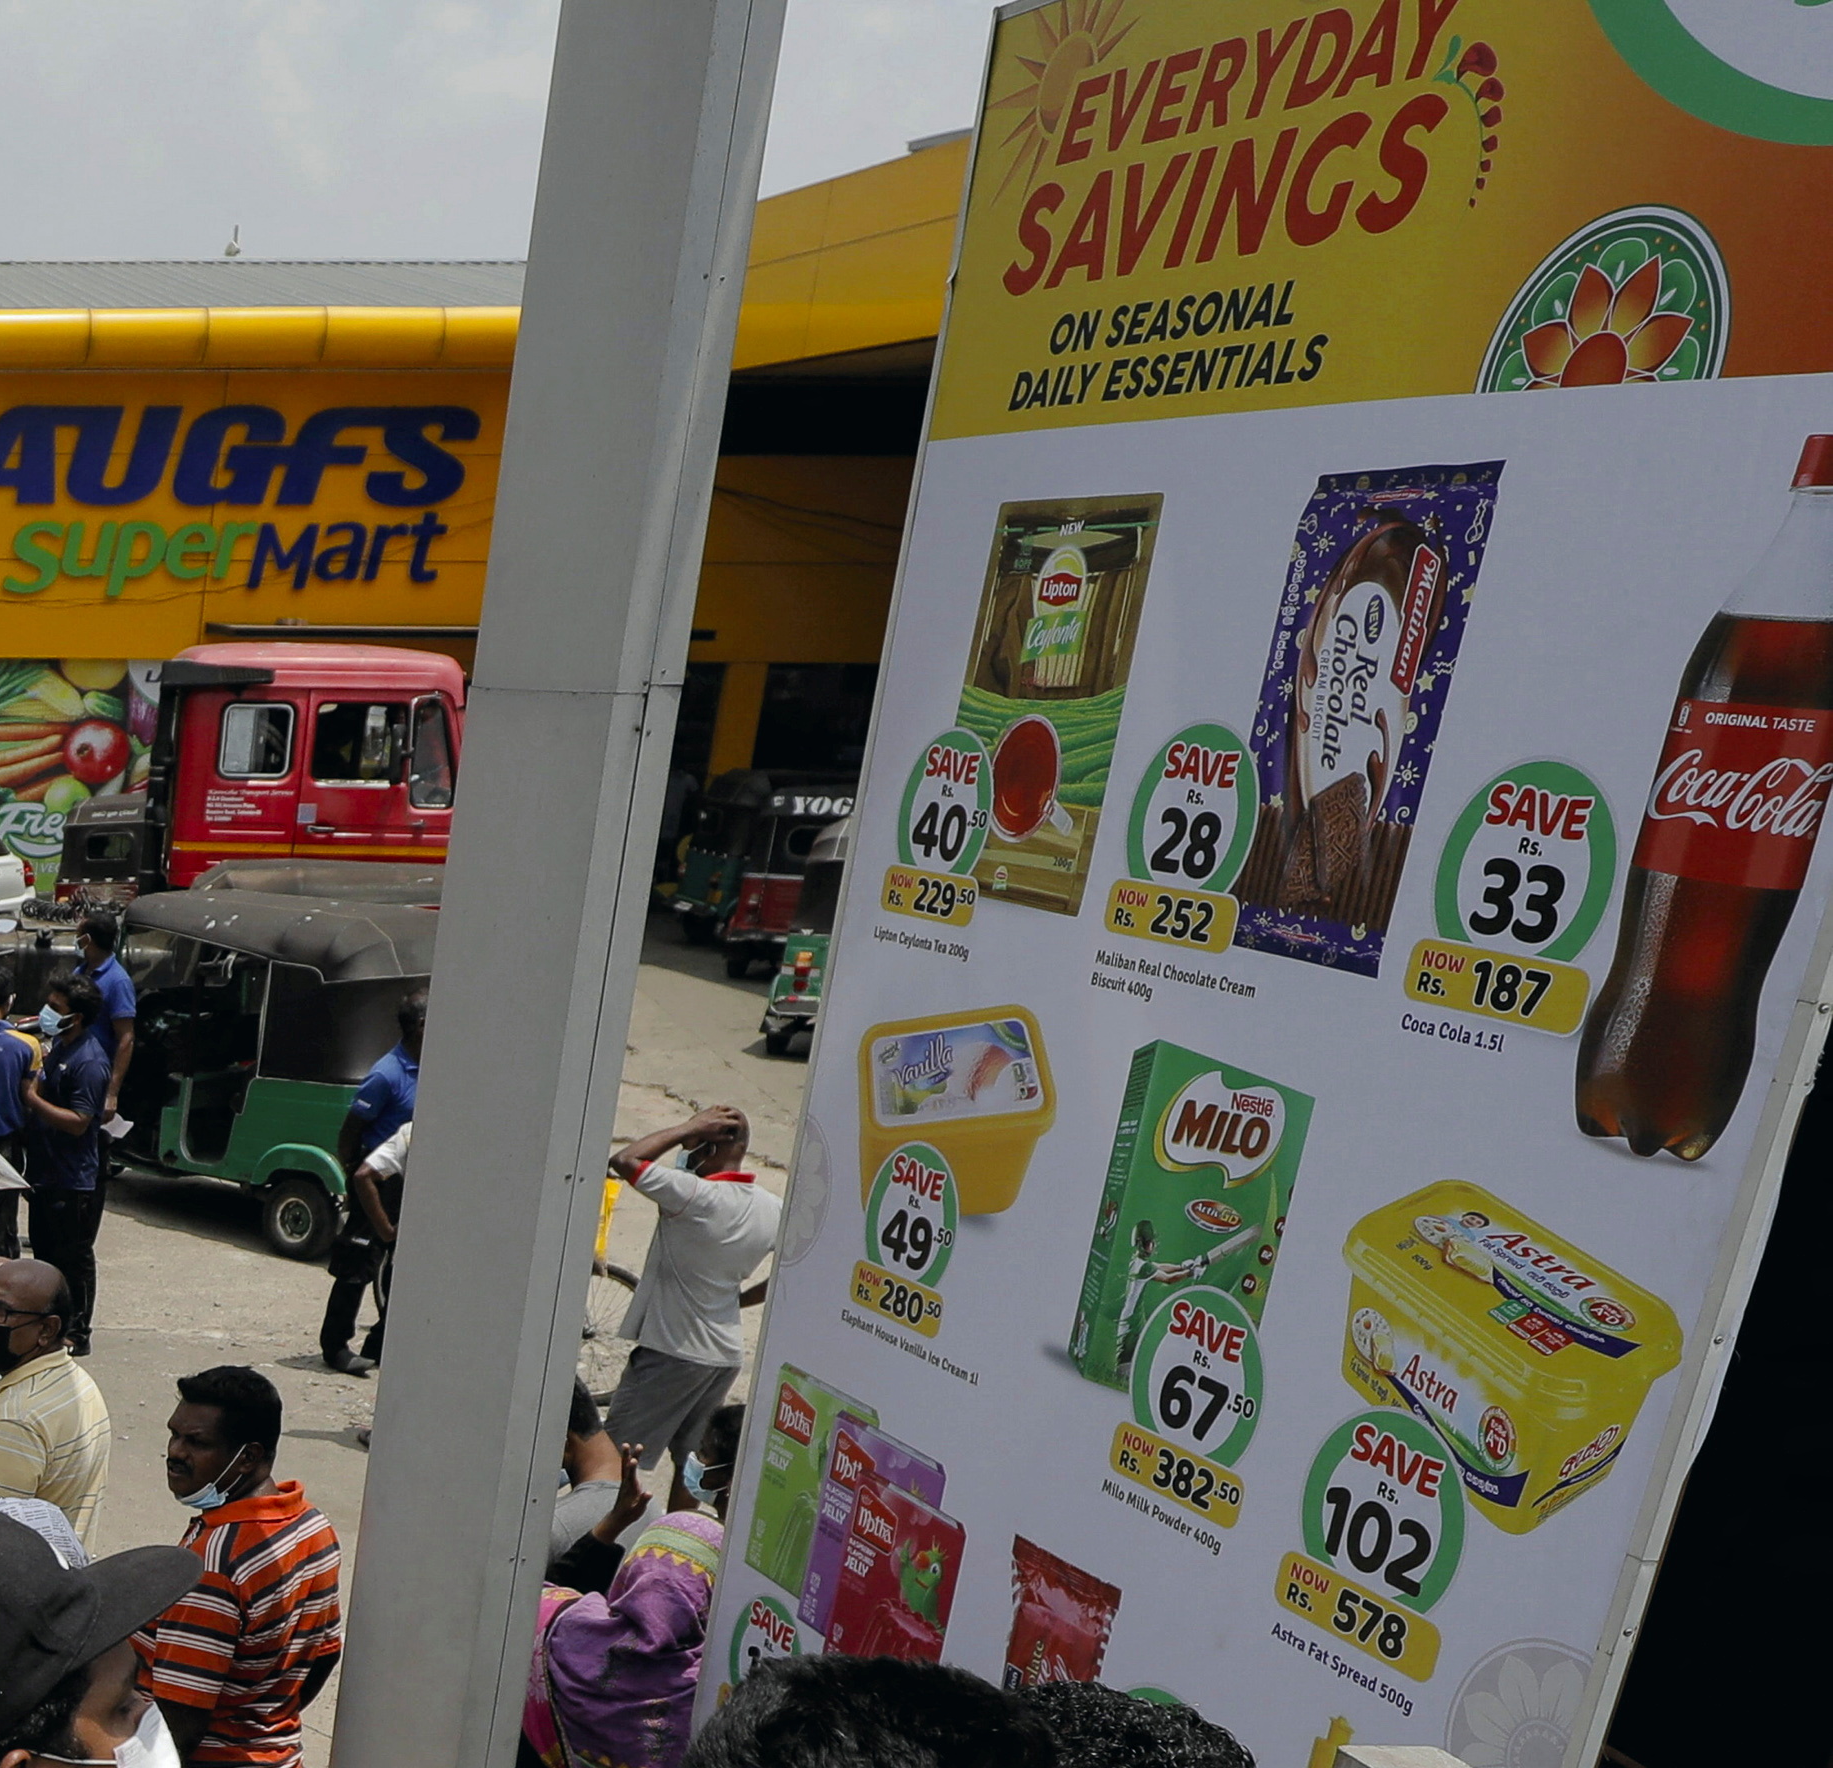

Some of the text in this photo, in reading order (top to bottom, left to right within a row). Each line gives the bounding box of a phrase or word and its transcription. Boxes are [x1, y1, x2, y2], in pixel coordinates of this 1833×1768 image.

[1056, 0, 1456, 166] EVERYDAY
[1001, 92, 1450, 297] SAVINGS
[1049, 280, 1295, 352] ON SEASONAL
[1007, 334, 1329, 412] DAILY ESSENTIALS
[1060, 520, 1084, 536] NEW
[1042, 579, 1077, 600] Lipton
[1369, 600, 1381, 638] NEW
[1397, 560, 1437, 679] Maliban
[1321, 613, 1358, 770] Chocolate
[1705, 711, 1816, 733] ORIGINAL TASTE
[925, 746, 981, 785] SAVE
[1164, 743, 1240, 789] SAVE
[941, 784, 954, 798] Rs.
[1186, 789, 1204, 806] Rs.
[1484, 782, 1596, 841] SAVE
[1150, 807, 1222, 879] 28
[1518, 836, 1543, 858] Rs.
[888, 890, 903, 907] Rs.
[891, 873, 914, 889] NOW
[1117, 888, 1149, 908] NOW
[1468, 856, 1567, 944] 33
[1113, 894, 1214, 942] Rs. 252
[874, 926, 970, 962] Lipton Ceylonta Tea 200g
[1421, 948, 1466, 974] NOW
[1091, 972, 1153, 1002] Biscuit 400g
[1095, 950, 1256, 999] Maliban Real Chocolate Cream
[1417, 960, 1552, 1018] Rs. 187
[1401, 1013, 1471, 1045] Coca Cola
[893, 1034, 953, 1089] Vanilla
[1171, 1099, 1271, 1159] MILO
[891, 1154, 947, 1202] SAVE
[859, 1268, 881, 1287] NOW
[1486, 1234, 1596, 1290] Astra
[1492, 1246, 1525, 1270] Spread
[856, 1283, 872, 1302] Rs.
[841, 1309, 969, 1380] Elephant House Vanilla Cream
[1169, 1302, 1246, 1363] SAVE
[1192, 1350, 1211, 1369] Rs.
[1401, 1354, 1458, 1415] Astra
[766, 1451, 790, 1472] JELLY
[1119, 1450, 1140, 1475] Rs.
[1123, 1431, 1154, 1457] NOW
[1350, 1424, 1444, 1498] SAVE
[822, 1501, 847, 1526] JELLY
[1376, 1481, 1399, 1505] Rs.
[1102, 1479, 1221, 1555] Milo Milk Powder 400g
[1325, 1487, 1432, 1599] 102
[844, 1555, 869, 1579] JELLY
[1289, 1562, 1330, 1594] NOW
[750, 1600, 797, 1652] SAVE
[1286, 1582, 1408, 1659] Rs. 578
[1271, 1622, 1413, 1717] Astra Fat Spread 500g
